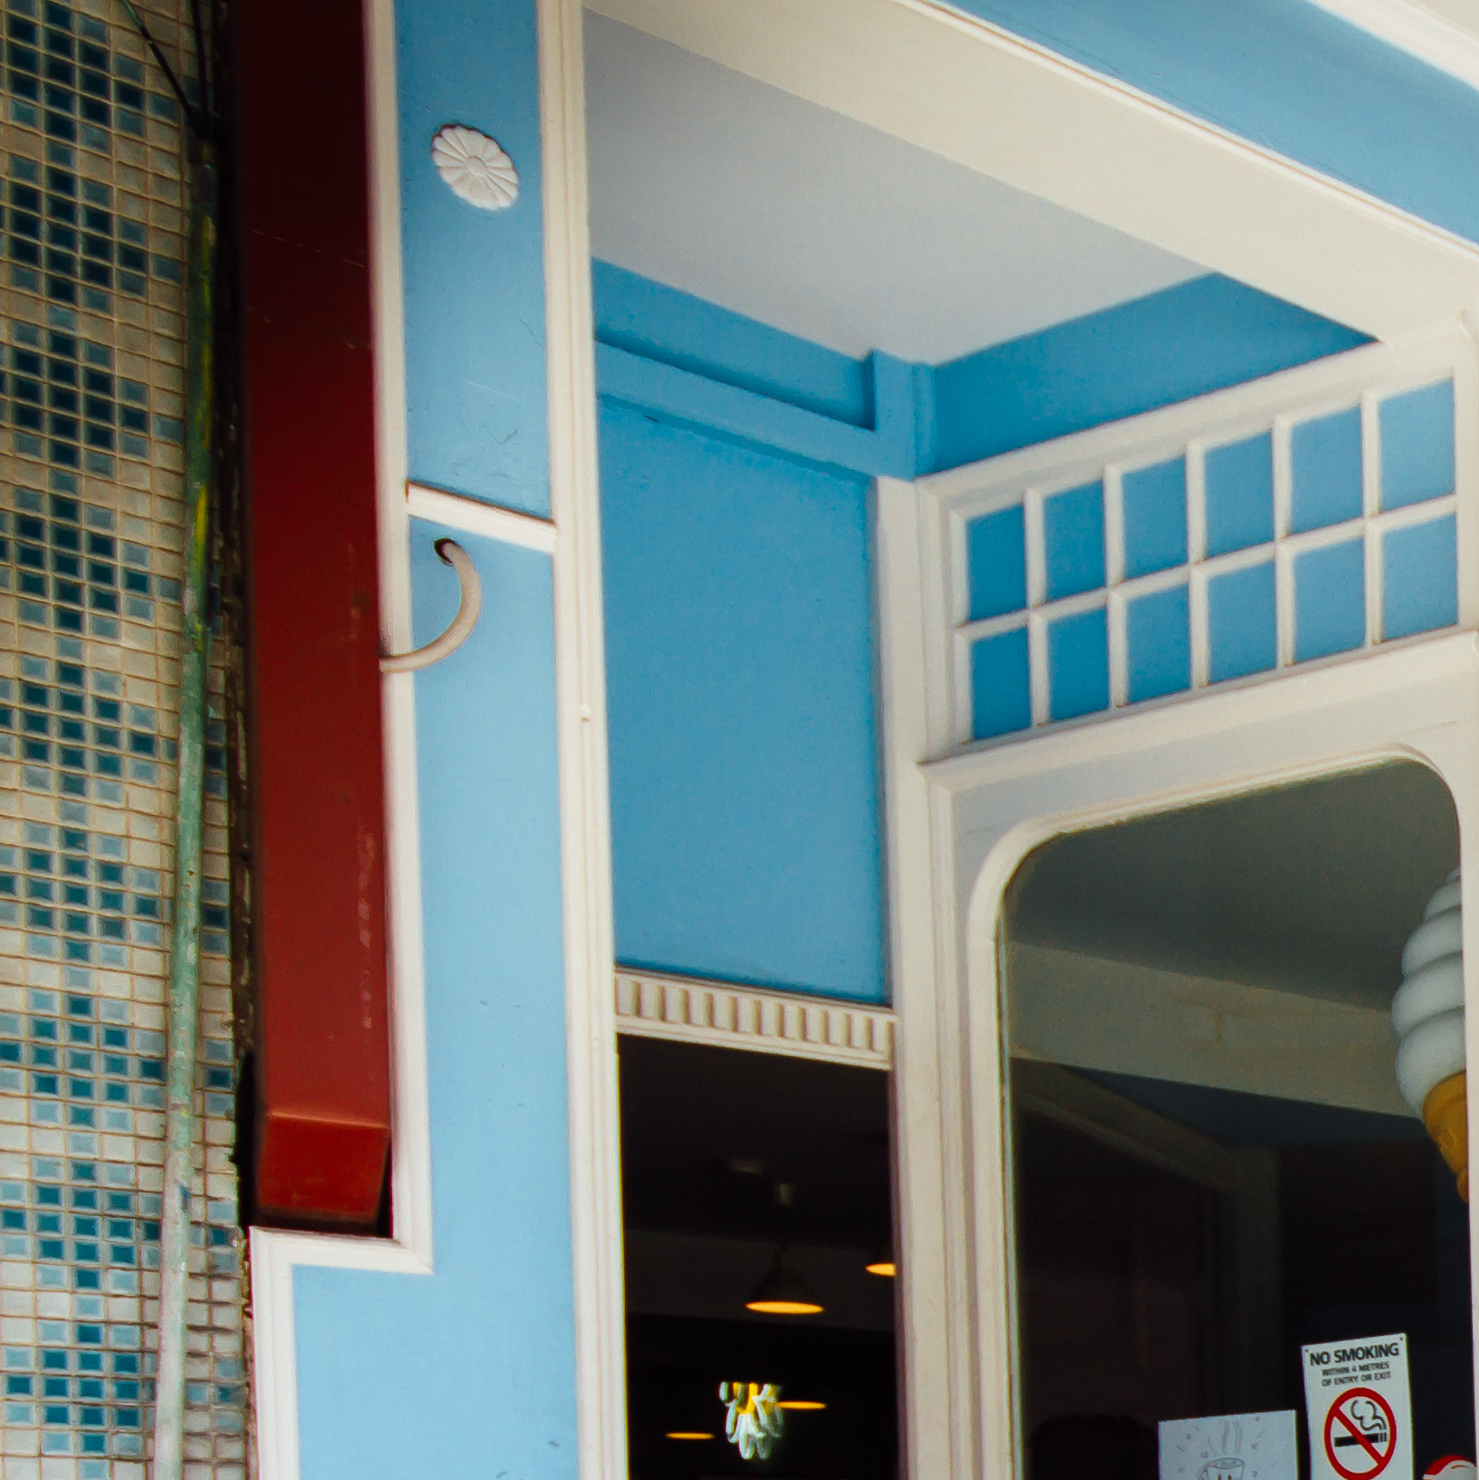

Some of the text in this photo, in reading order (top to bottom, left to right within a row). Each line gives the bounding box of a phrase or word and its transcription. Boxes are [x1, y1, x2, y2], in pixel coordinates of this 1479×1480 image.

[1309, 1342, 1399, 1366] NO SMOKING
[1322, 1366, 1350, 1376] WITHIN
[1359, 1361, 1390, 1372] METRES
[1334, 1375, 1359, 1386] ENTRY
[1374, 1371, 1391, 1380] EXIT
